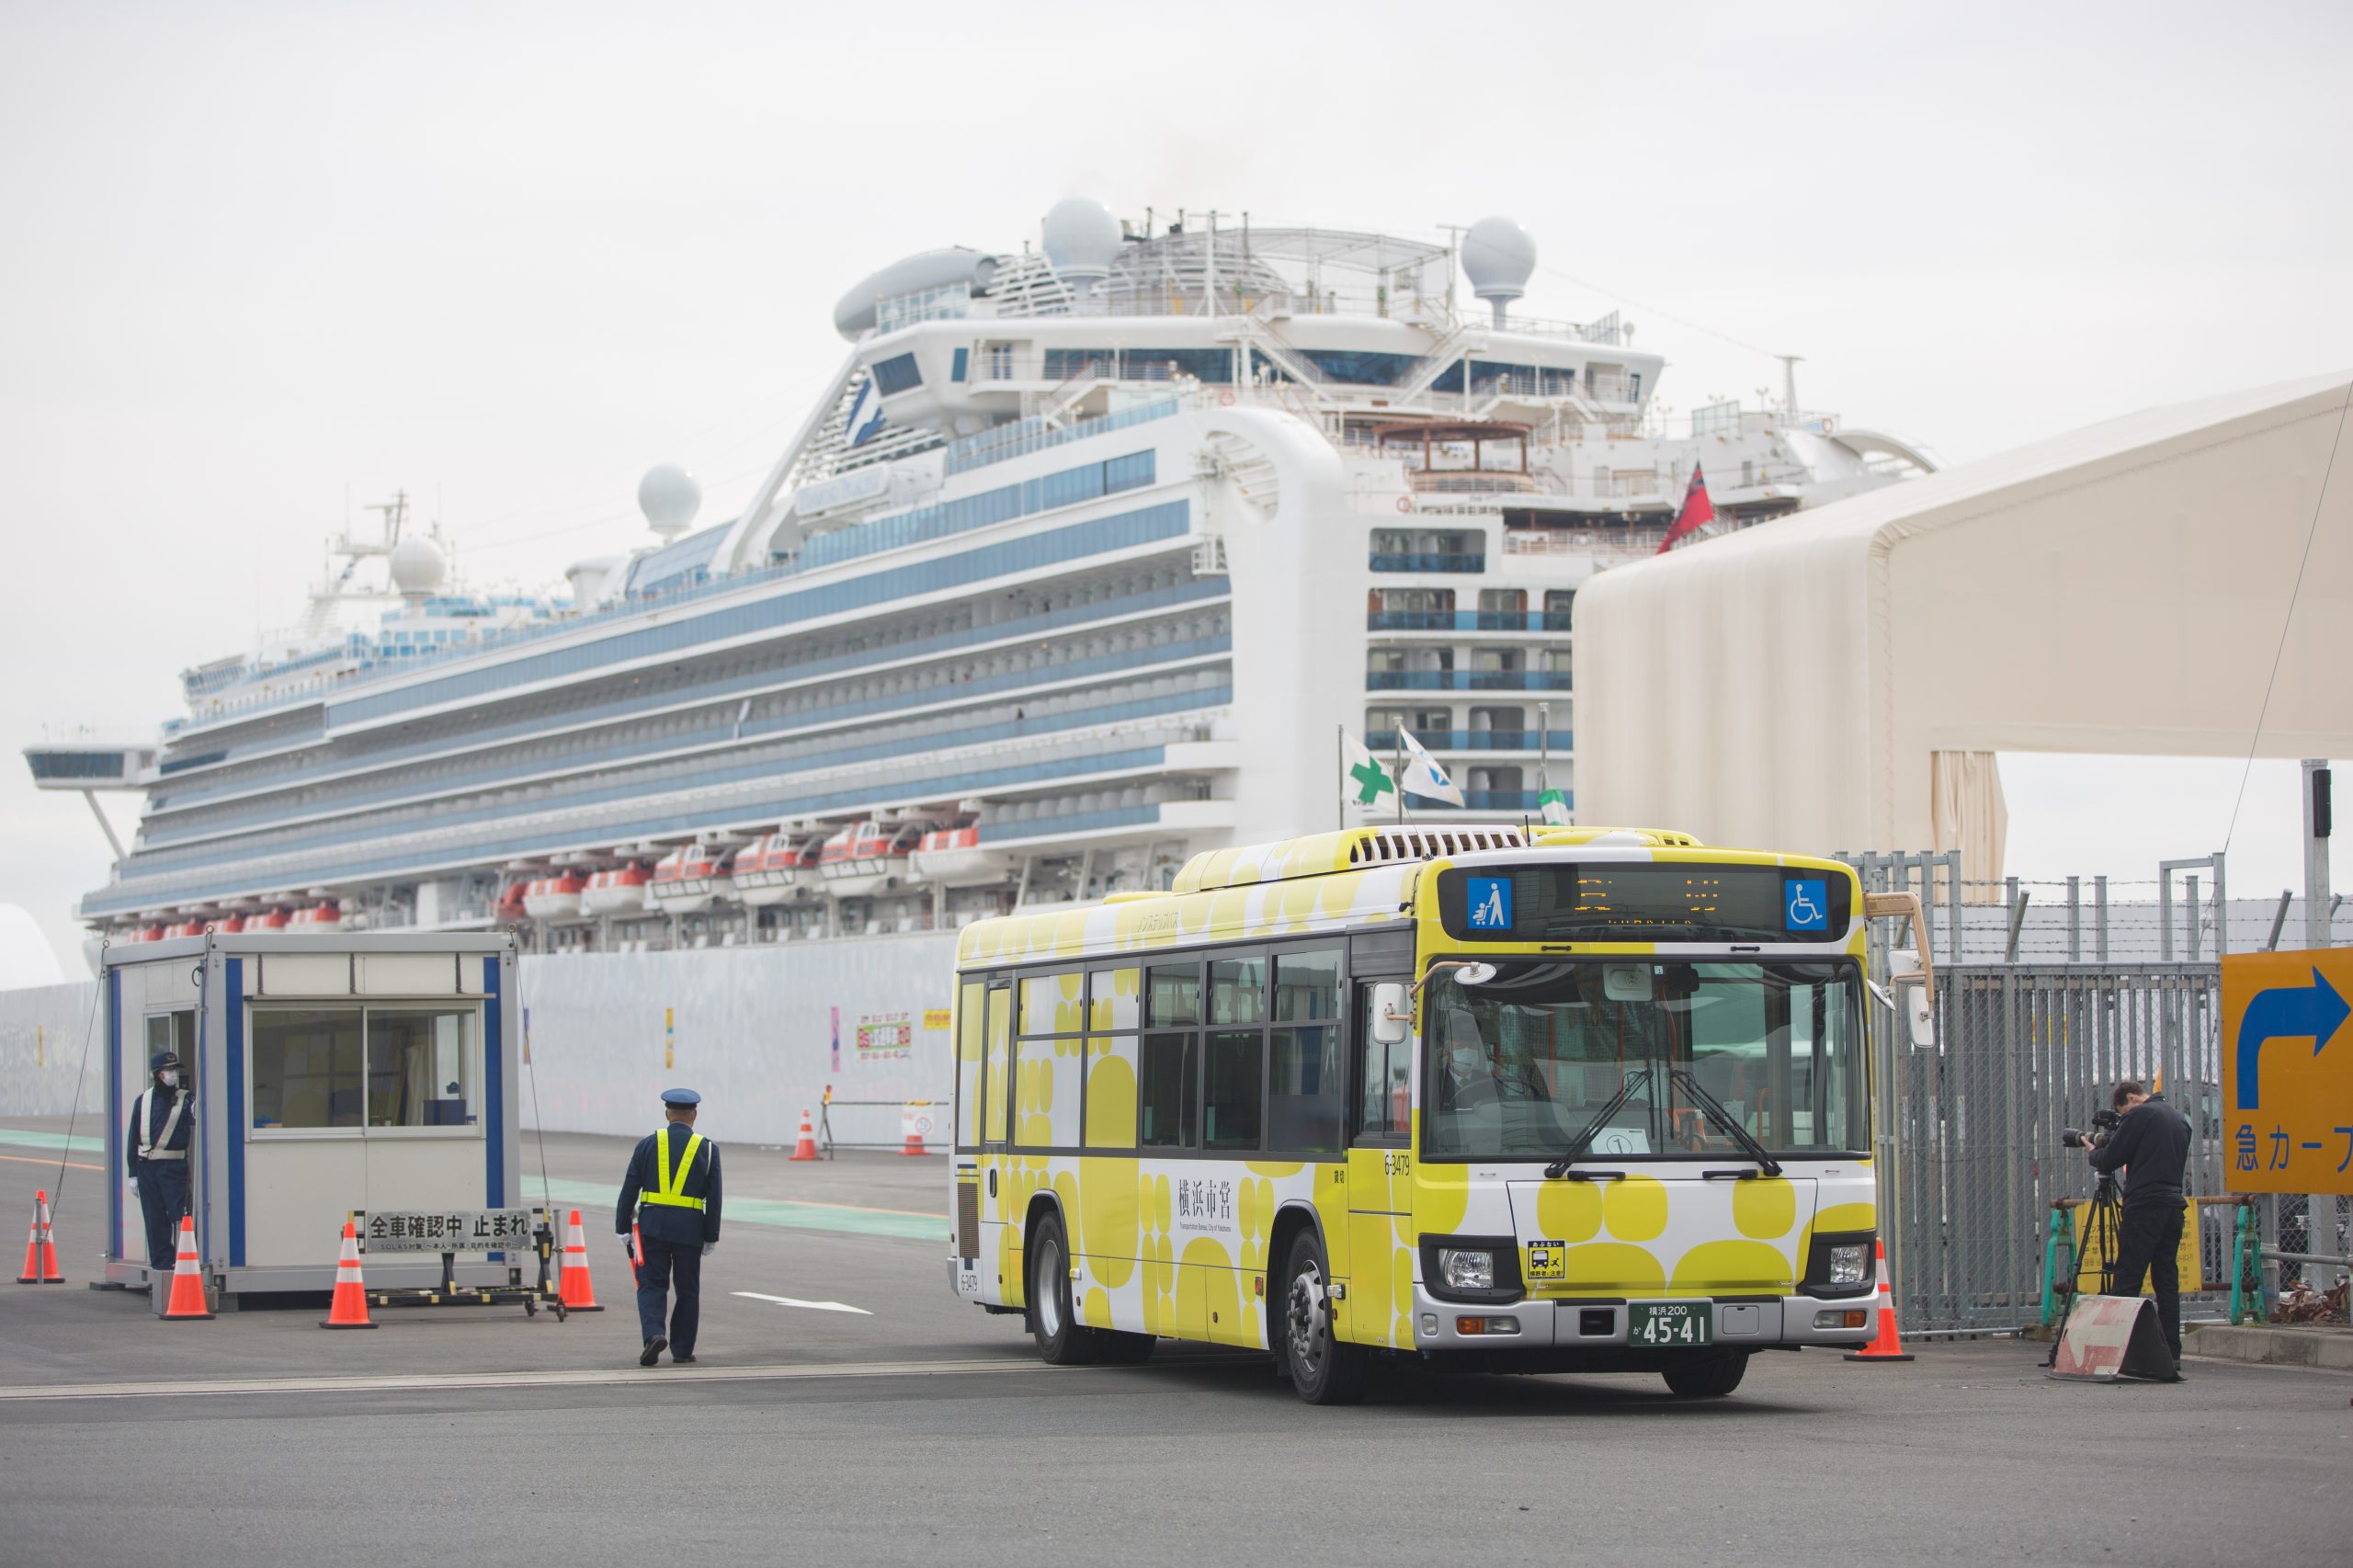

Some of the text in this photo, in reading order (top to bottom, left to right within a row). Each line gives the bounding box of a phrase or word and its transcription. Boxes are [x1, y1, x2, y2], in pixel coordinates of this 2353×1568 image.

[1384, 1154, 1410, 1176] 6-3479
[1176, 1179, 1231, 1220] 横浜市営
[370, 1214, 529, 1239] 全車確認中 止まれ
[961, 1274, 978, 1291] 6-3479
[1632, 1316, 1705, 1344] か 45-41
